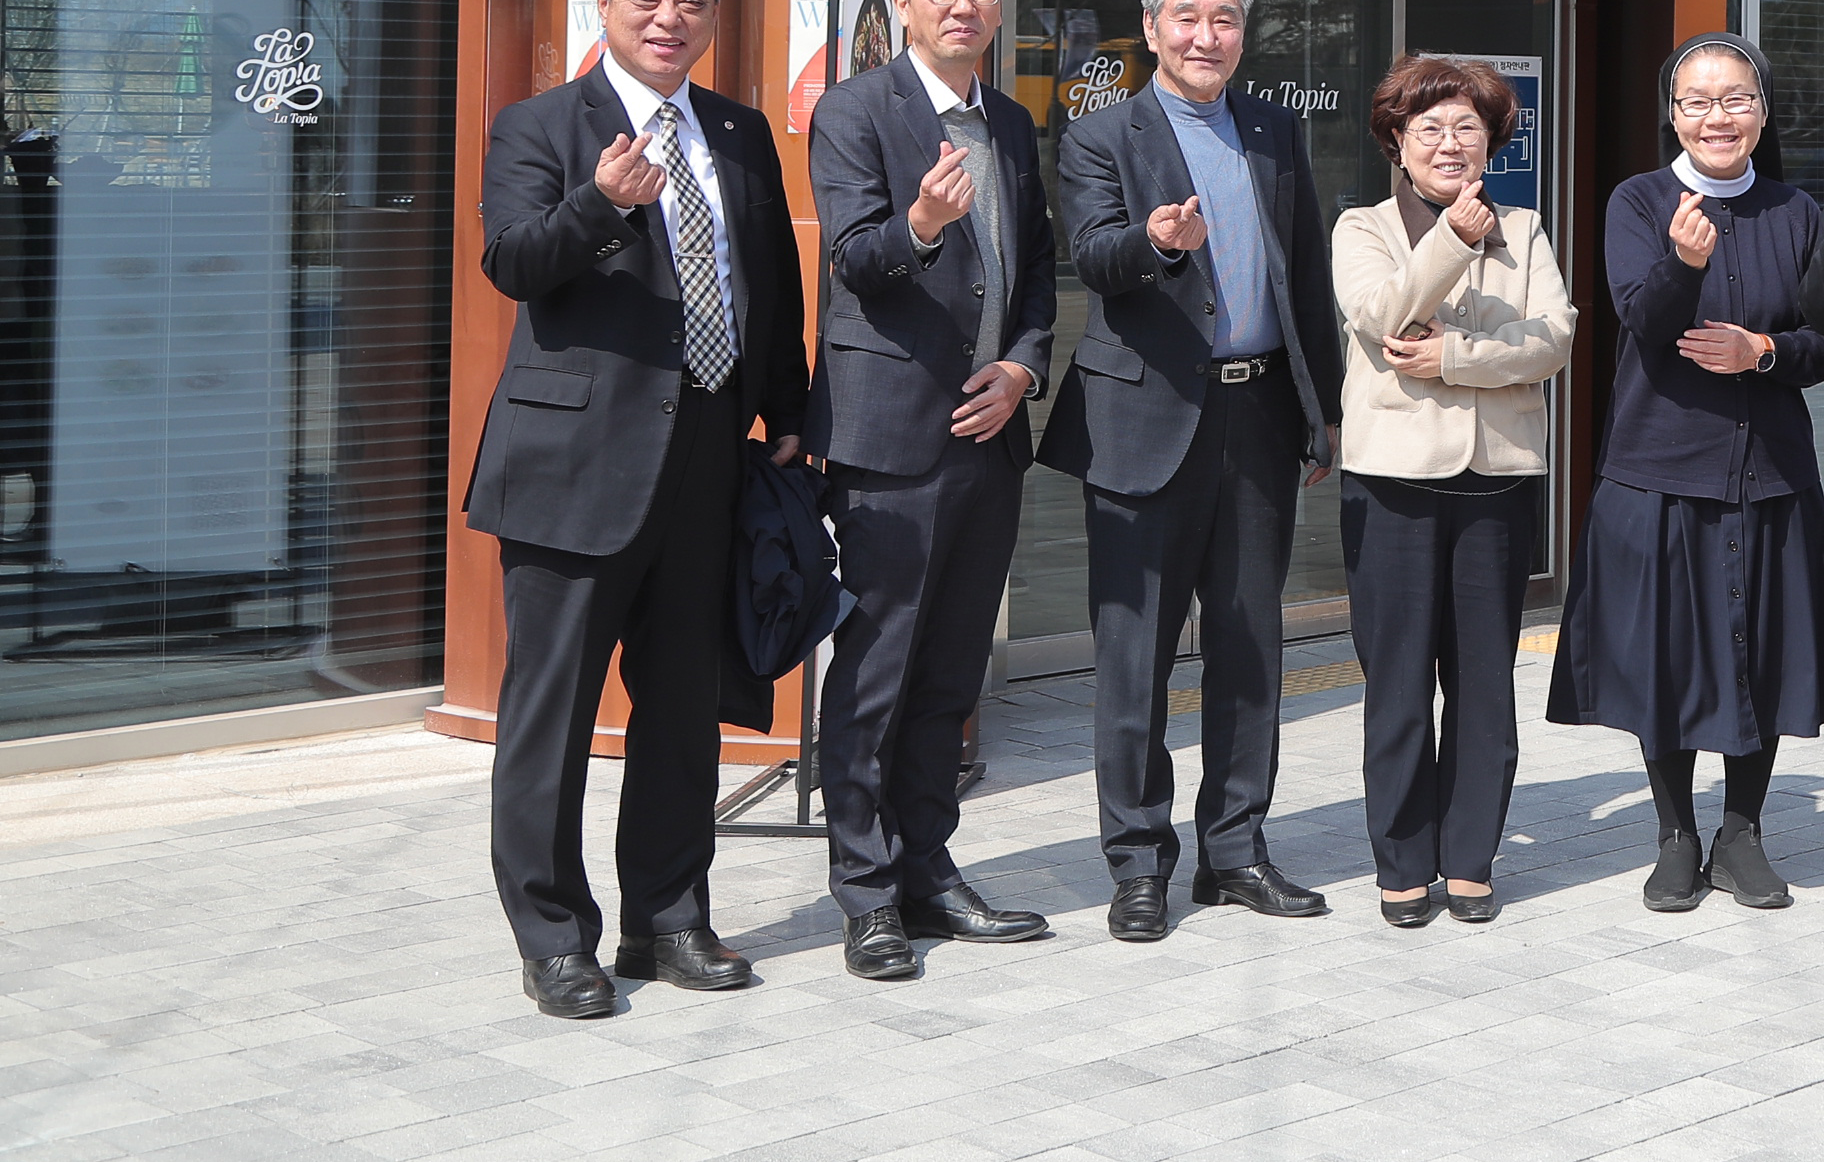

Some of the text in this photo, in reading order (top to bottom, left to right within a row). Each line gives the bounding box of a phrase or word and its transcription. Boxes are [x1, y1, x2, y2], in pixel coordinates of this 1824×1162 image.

[1279, 81, 1340, 119] Topia
[273, 112, 319, 128] La Topia
